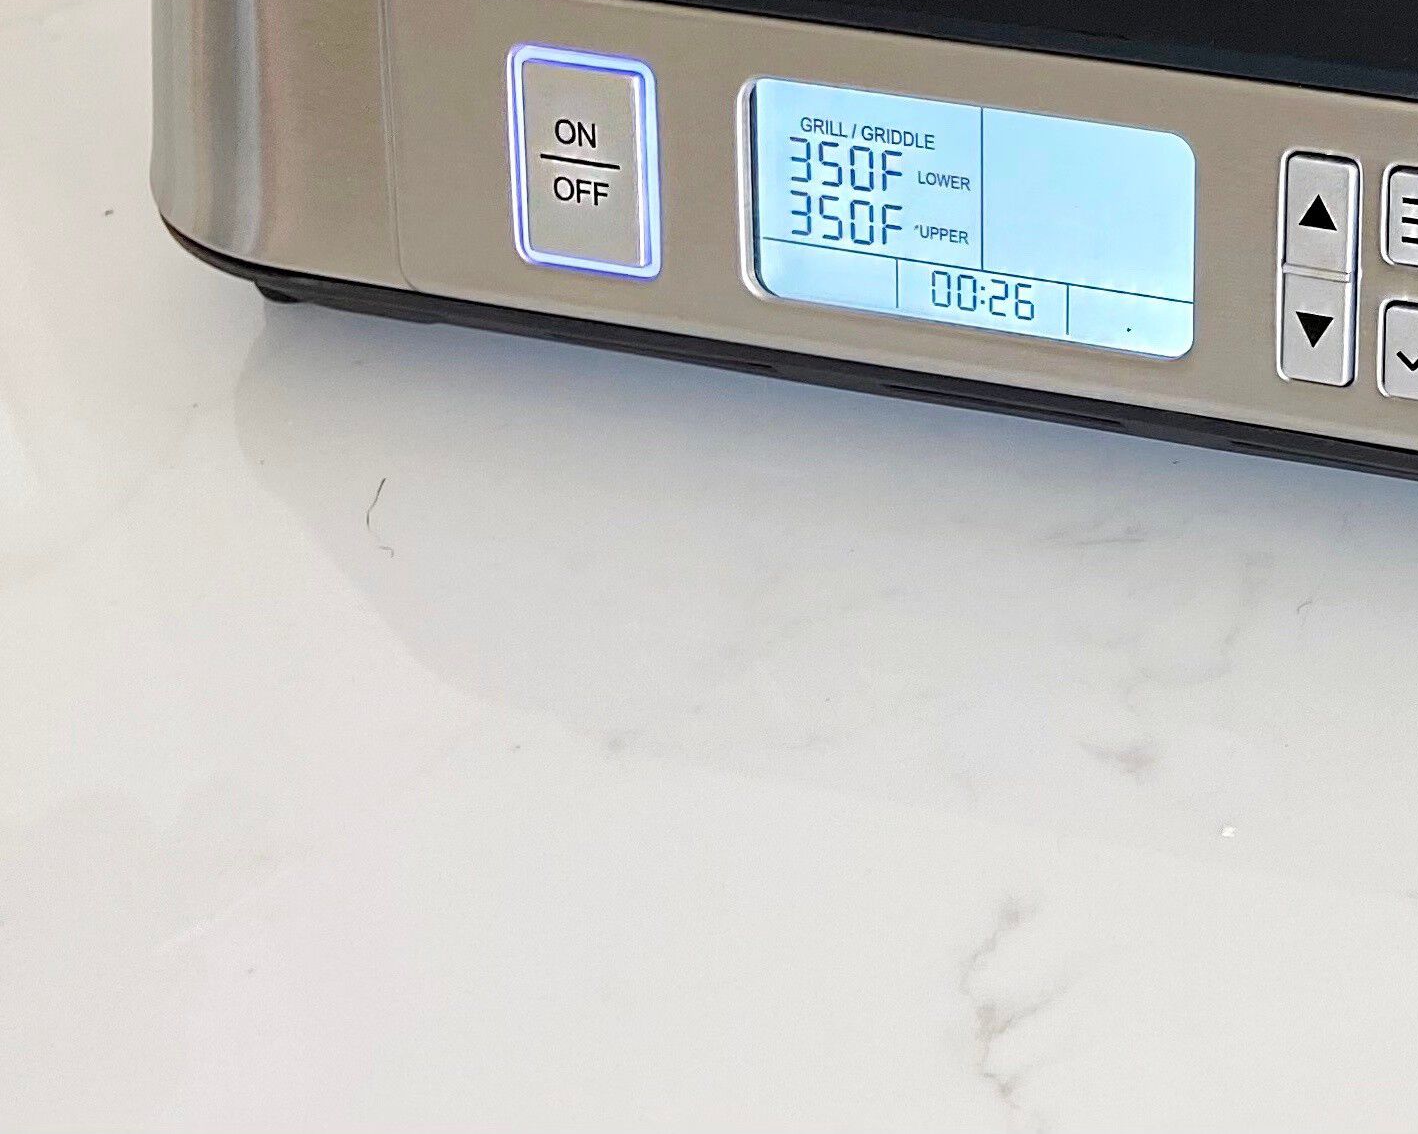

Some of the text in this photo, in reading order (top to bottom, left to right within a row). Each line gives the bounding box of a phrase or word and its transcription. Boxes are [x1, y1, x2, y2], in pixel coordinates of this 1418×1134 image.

[554, 119, 597, 149] ON
[800, 116, 848, 138] GRILL
[861, 125, 936, 151] GRIDDLE
[789, 136, 971, 192] 350F LOWER
[553, 176, 610, 206] OFF
[790, 189, 970, 246] 350F UPPER
[931, 270, 1036, 322] 00:26
